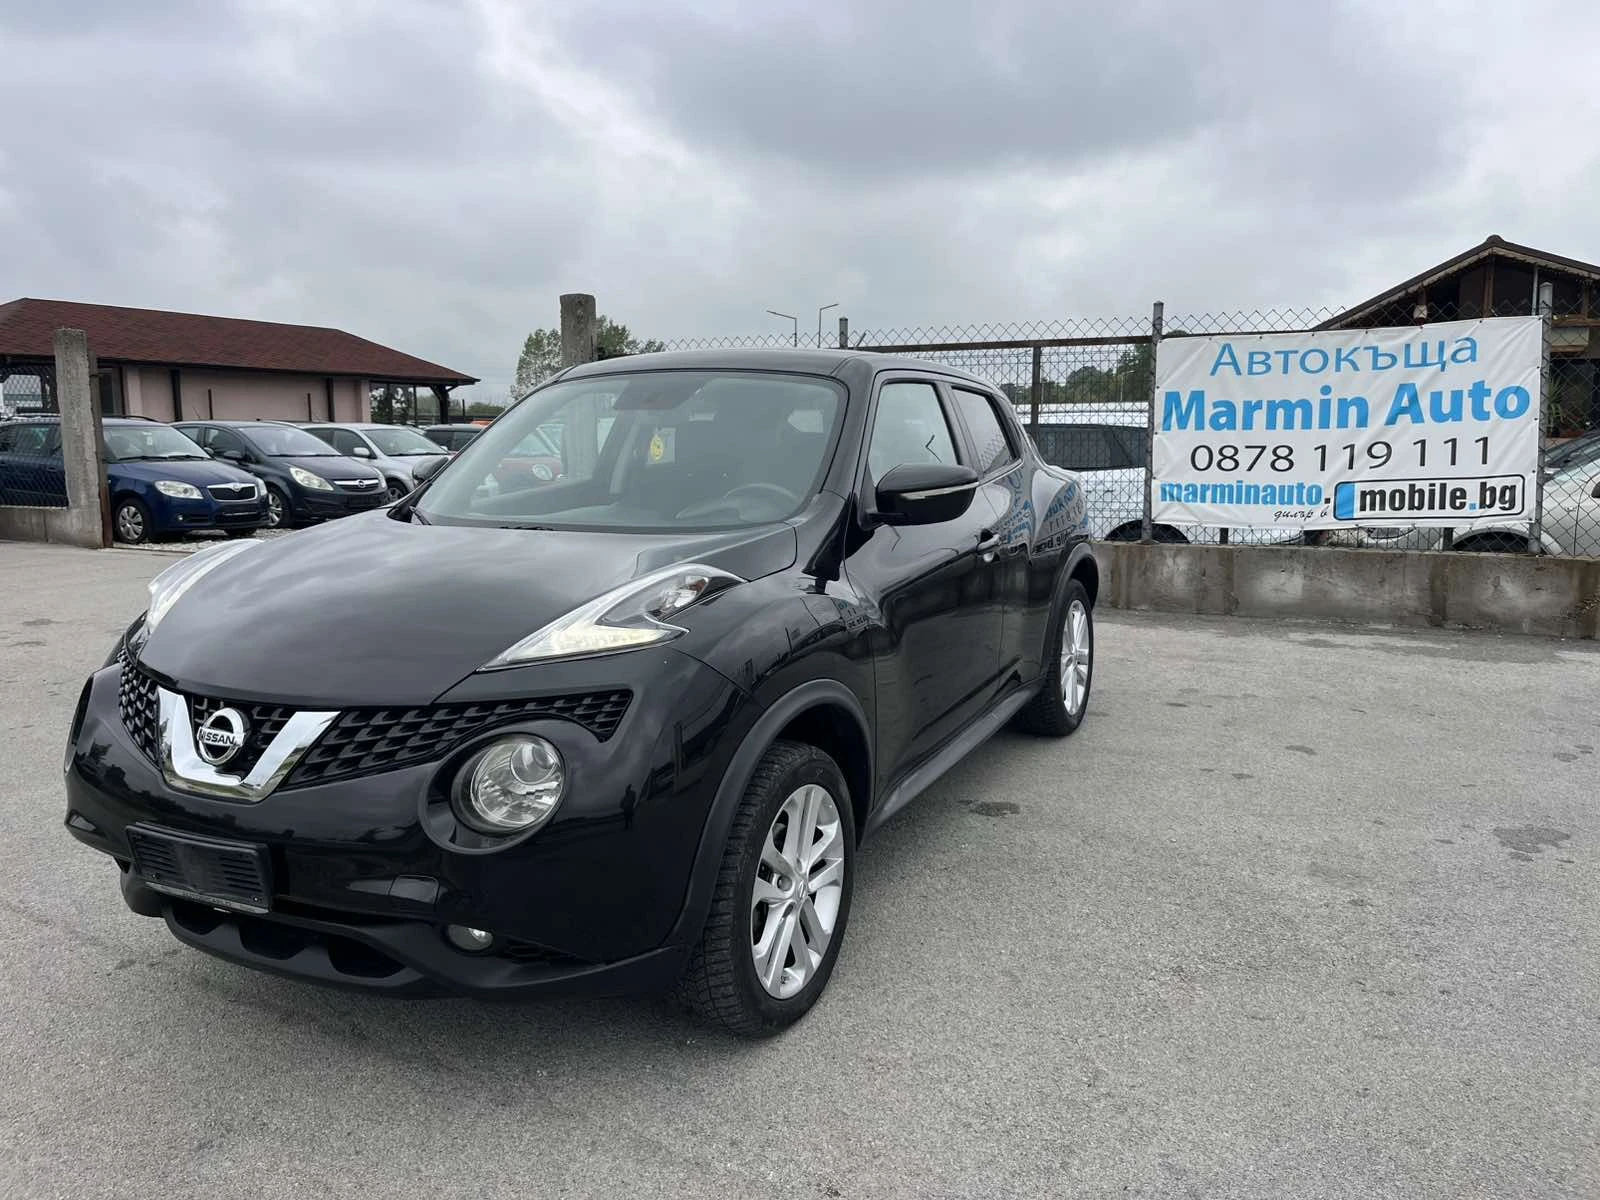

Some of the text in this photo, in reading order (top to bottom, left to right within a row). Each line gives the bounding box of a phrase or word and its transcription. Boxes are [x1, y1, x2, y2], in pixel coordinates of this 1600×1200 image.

[1210, 336, 1478, 376] Автокъща
[1161, 379, 1532, 432] Marmin Auto
[1190, 436, 1490, 472] 0878 119 111
[1359, 481, 1517, 511] mobile.bg
[199, 729, 236, 745] NISSAN
